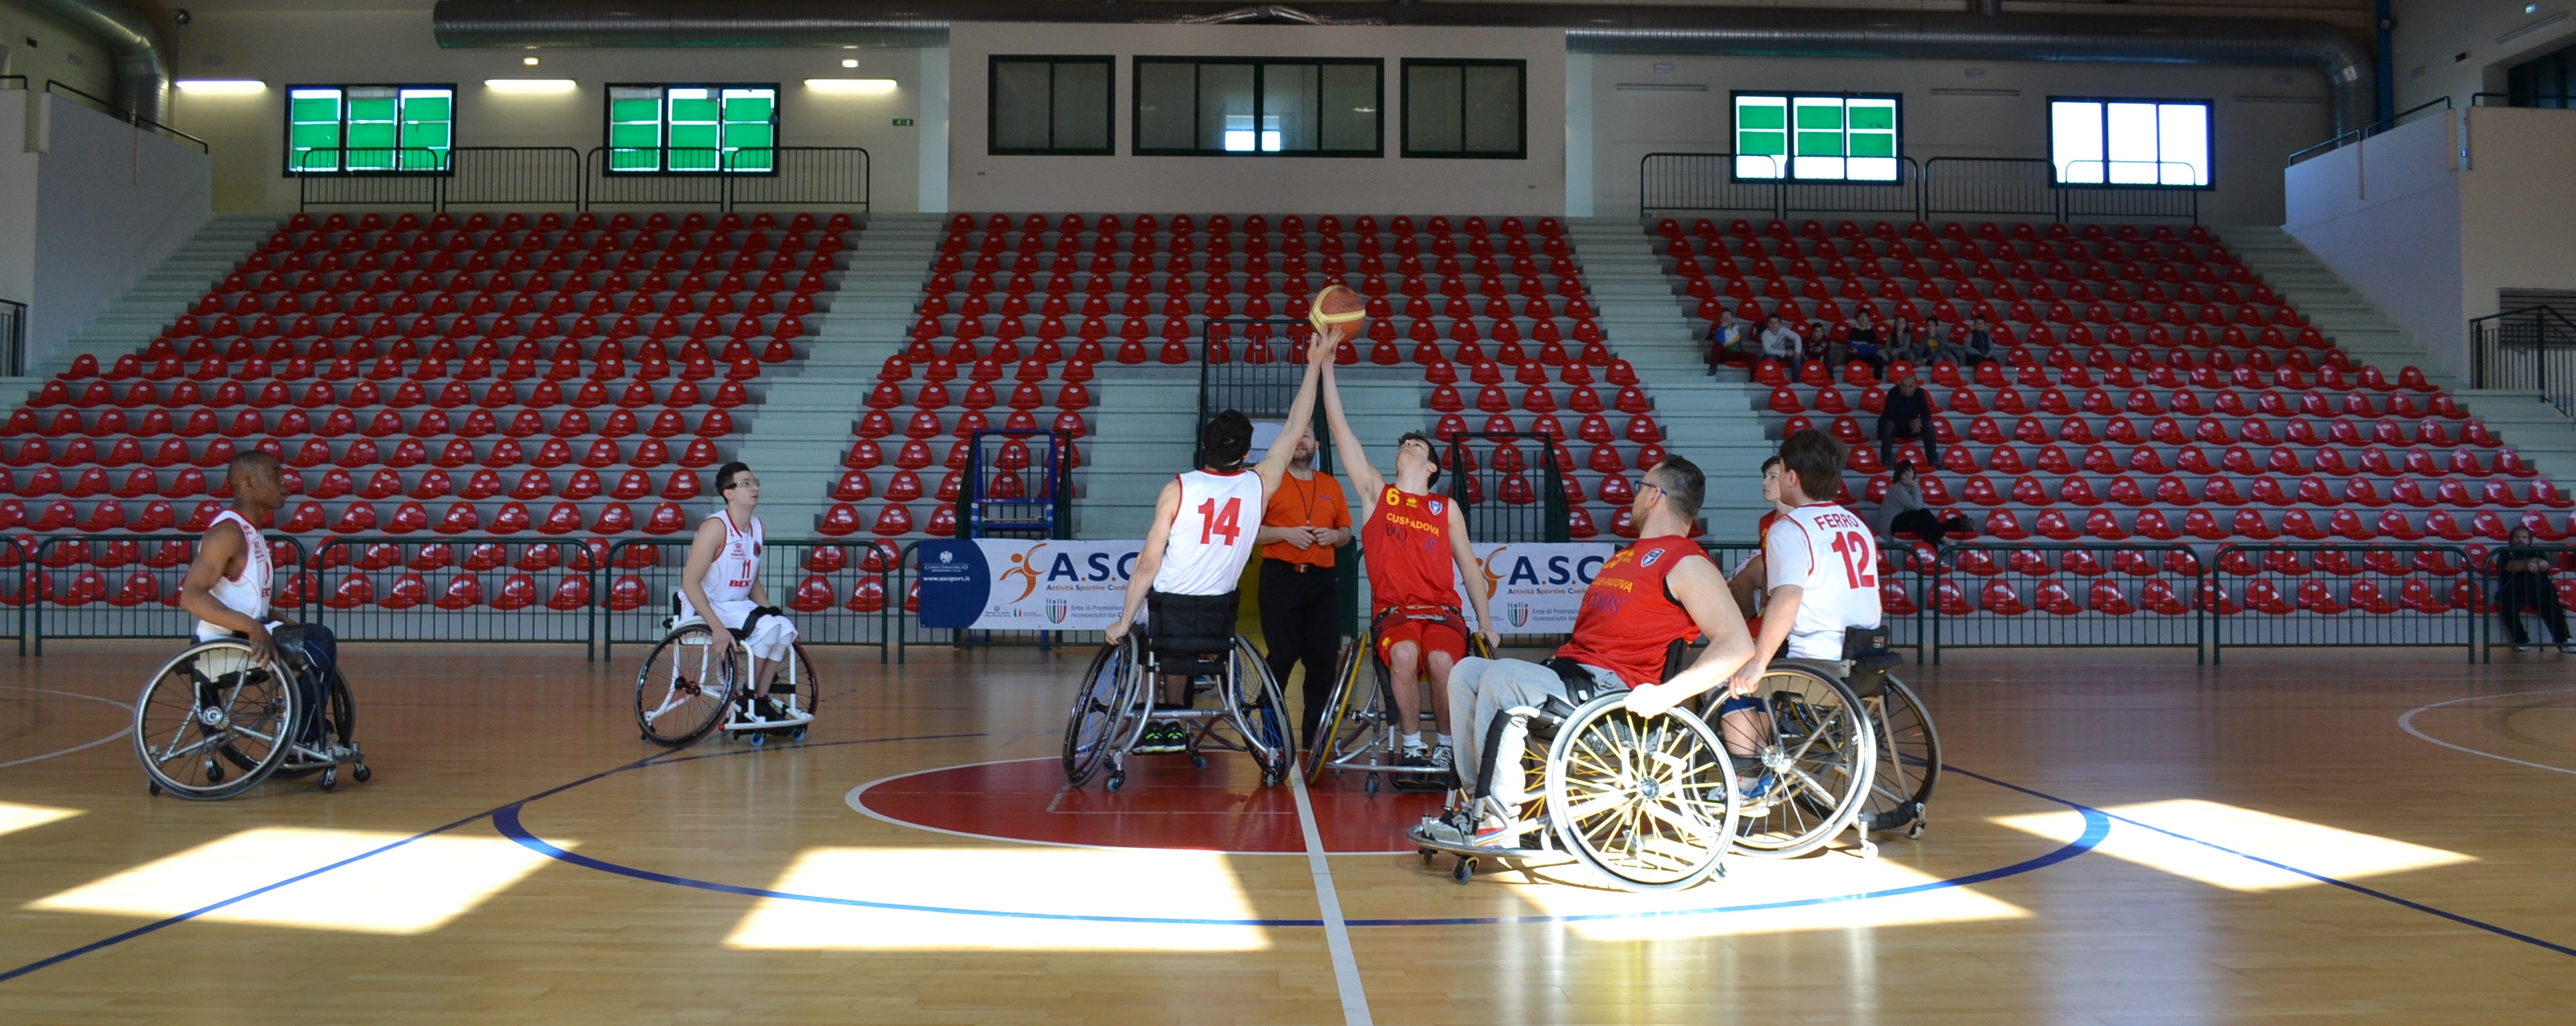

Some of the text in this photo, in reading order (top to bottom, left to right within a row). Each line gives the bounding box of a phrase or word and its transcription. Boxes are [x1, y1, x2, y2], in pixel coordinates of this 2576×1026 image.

[1386, 487, 1401, 506] 6
[1198, 497, 1242, 547] 14
[1813, 513, 1860, 531] FERRO
[742, 559, 751, 579] 11
[1831, 530, 1875, 590] 12
[1076, 584, 1105, 592] Sportive
[1536, 588, 1566, 596] Sportive
